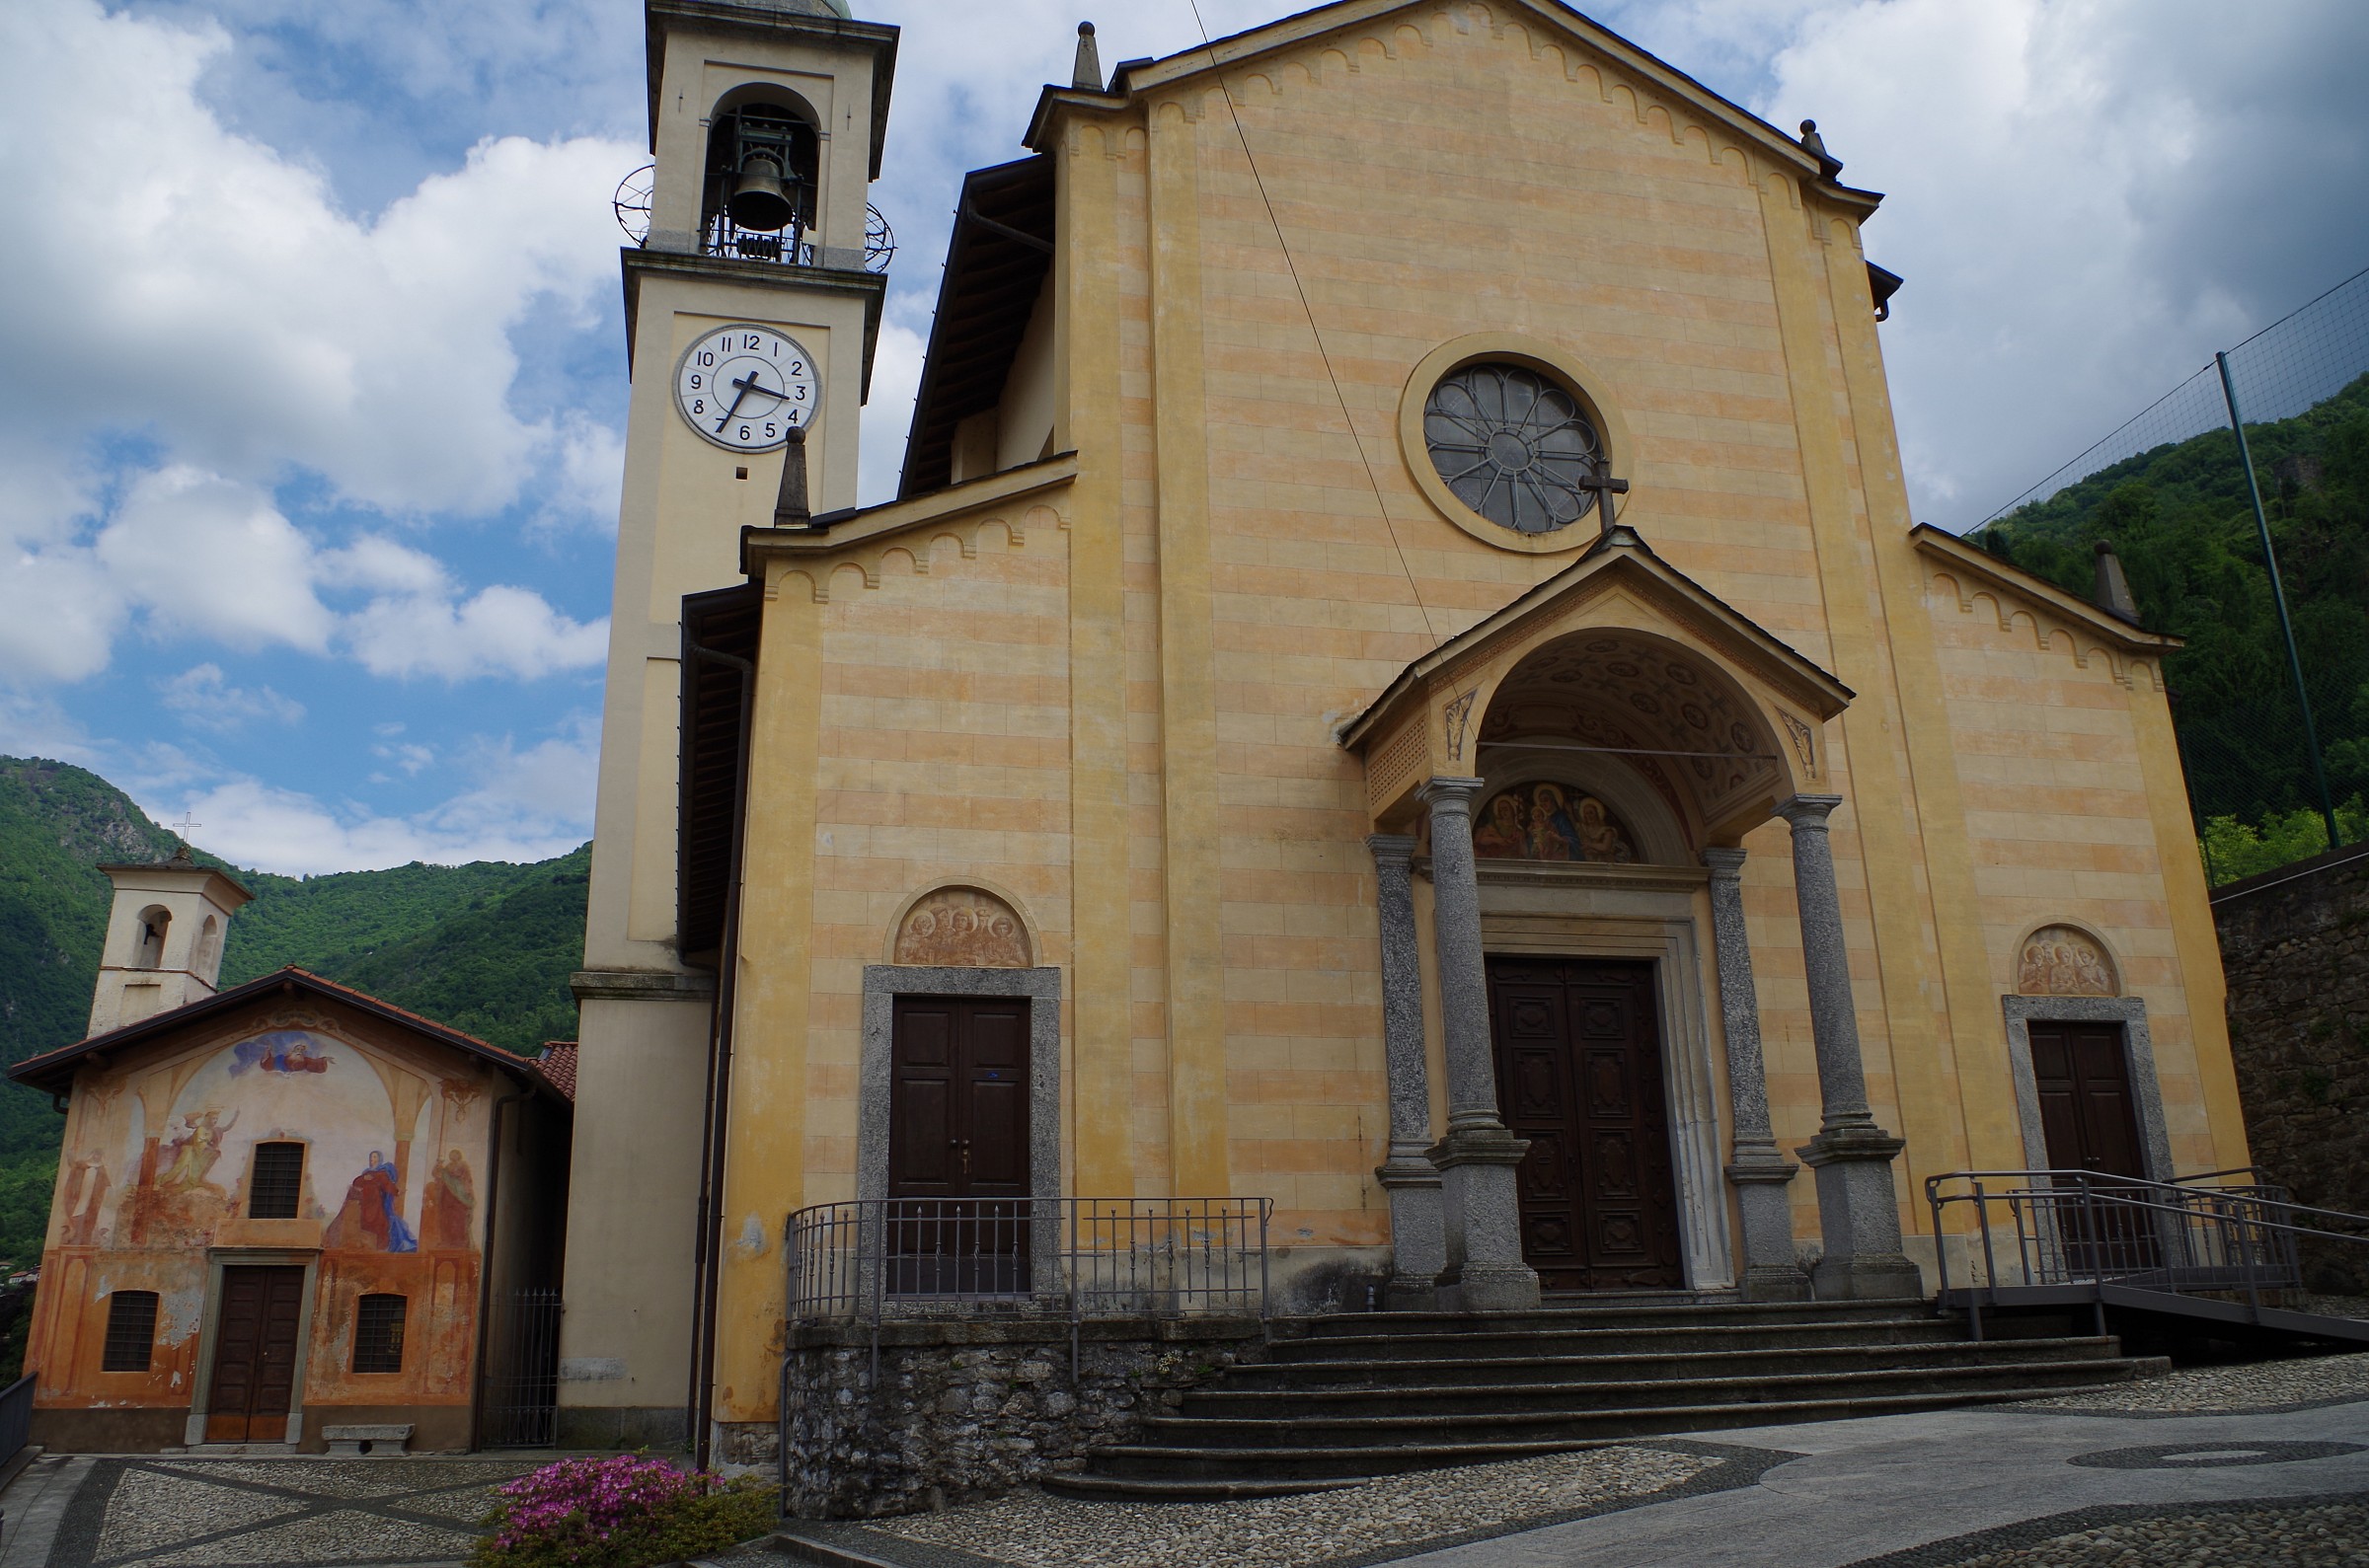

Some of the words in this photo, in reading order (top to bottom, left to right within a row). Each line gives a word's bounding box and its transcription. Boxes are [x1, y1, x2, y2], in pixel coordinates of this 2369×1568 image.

[722, 336, 731, 352] 11
[743, 335, 760, 350] 12
[774, 341, 778, 356] 1
[697, 351, 714, 366] 10
[791, 361, 802, 376] 2
[691, 374, 702, 390] 9
[795, 385, 806, 401] 3
[693, 400, 704, 414] 8
[788, 409, 799, 423] 4
[739, 425, 750, 440] 6
[765, 422, 776, 438] 5
